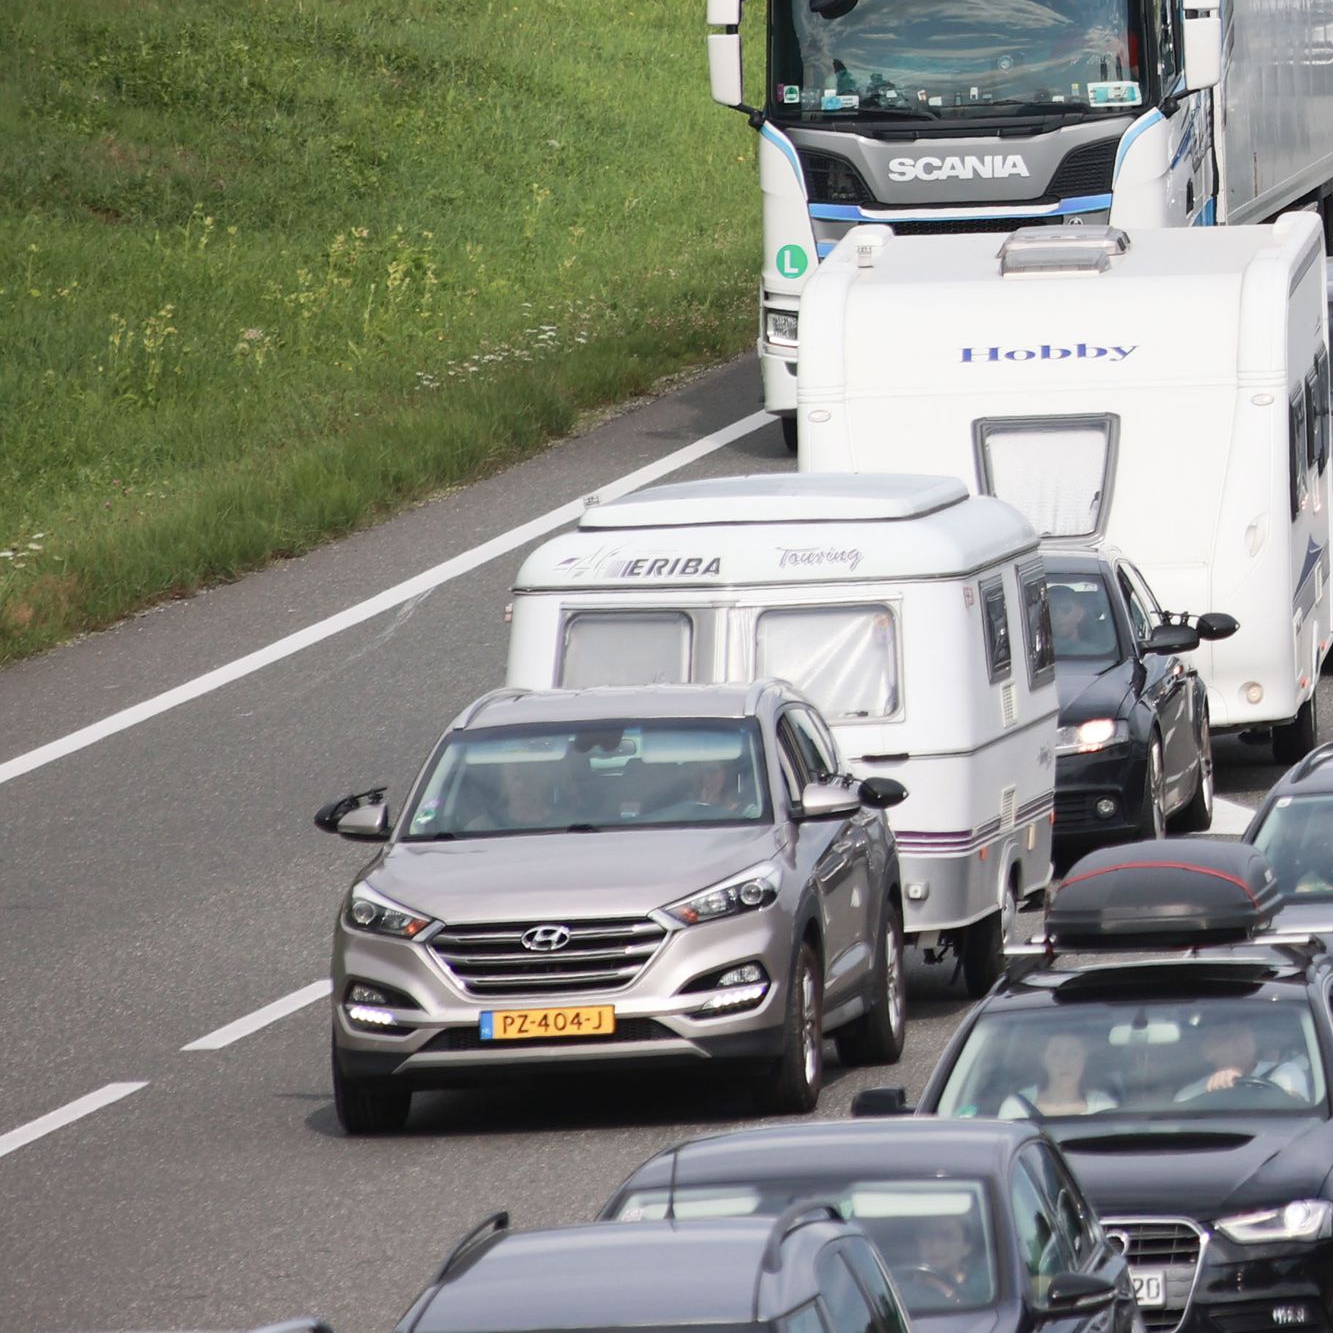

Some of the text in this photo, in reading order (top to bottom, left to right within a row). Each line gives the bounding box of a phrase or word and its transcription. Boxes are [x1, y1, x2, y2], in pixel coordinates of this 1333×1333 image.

[888, 154, 1030, 182] SCANIA
[784, 250, 799, 274] L
[958, 343, 1140, 363] Hobby
[628, 546, 864, 578] ERIBA Touring
[502, 1011, 602, 1034] PZ-404-J
